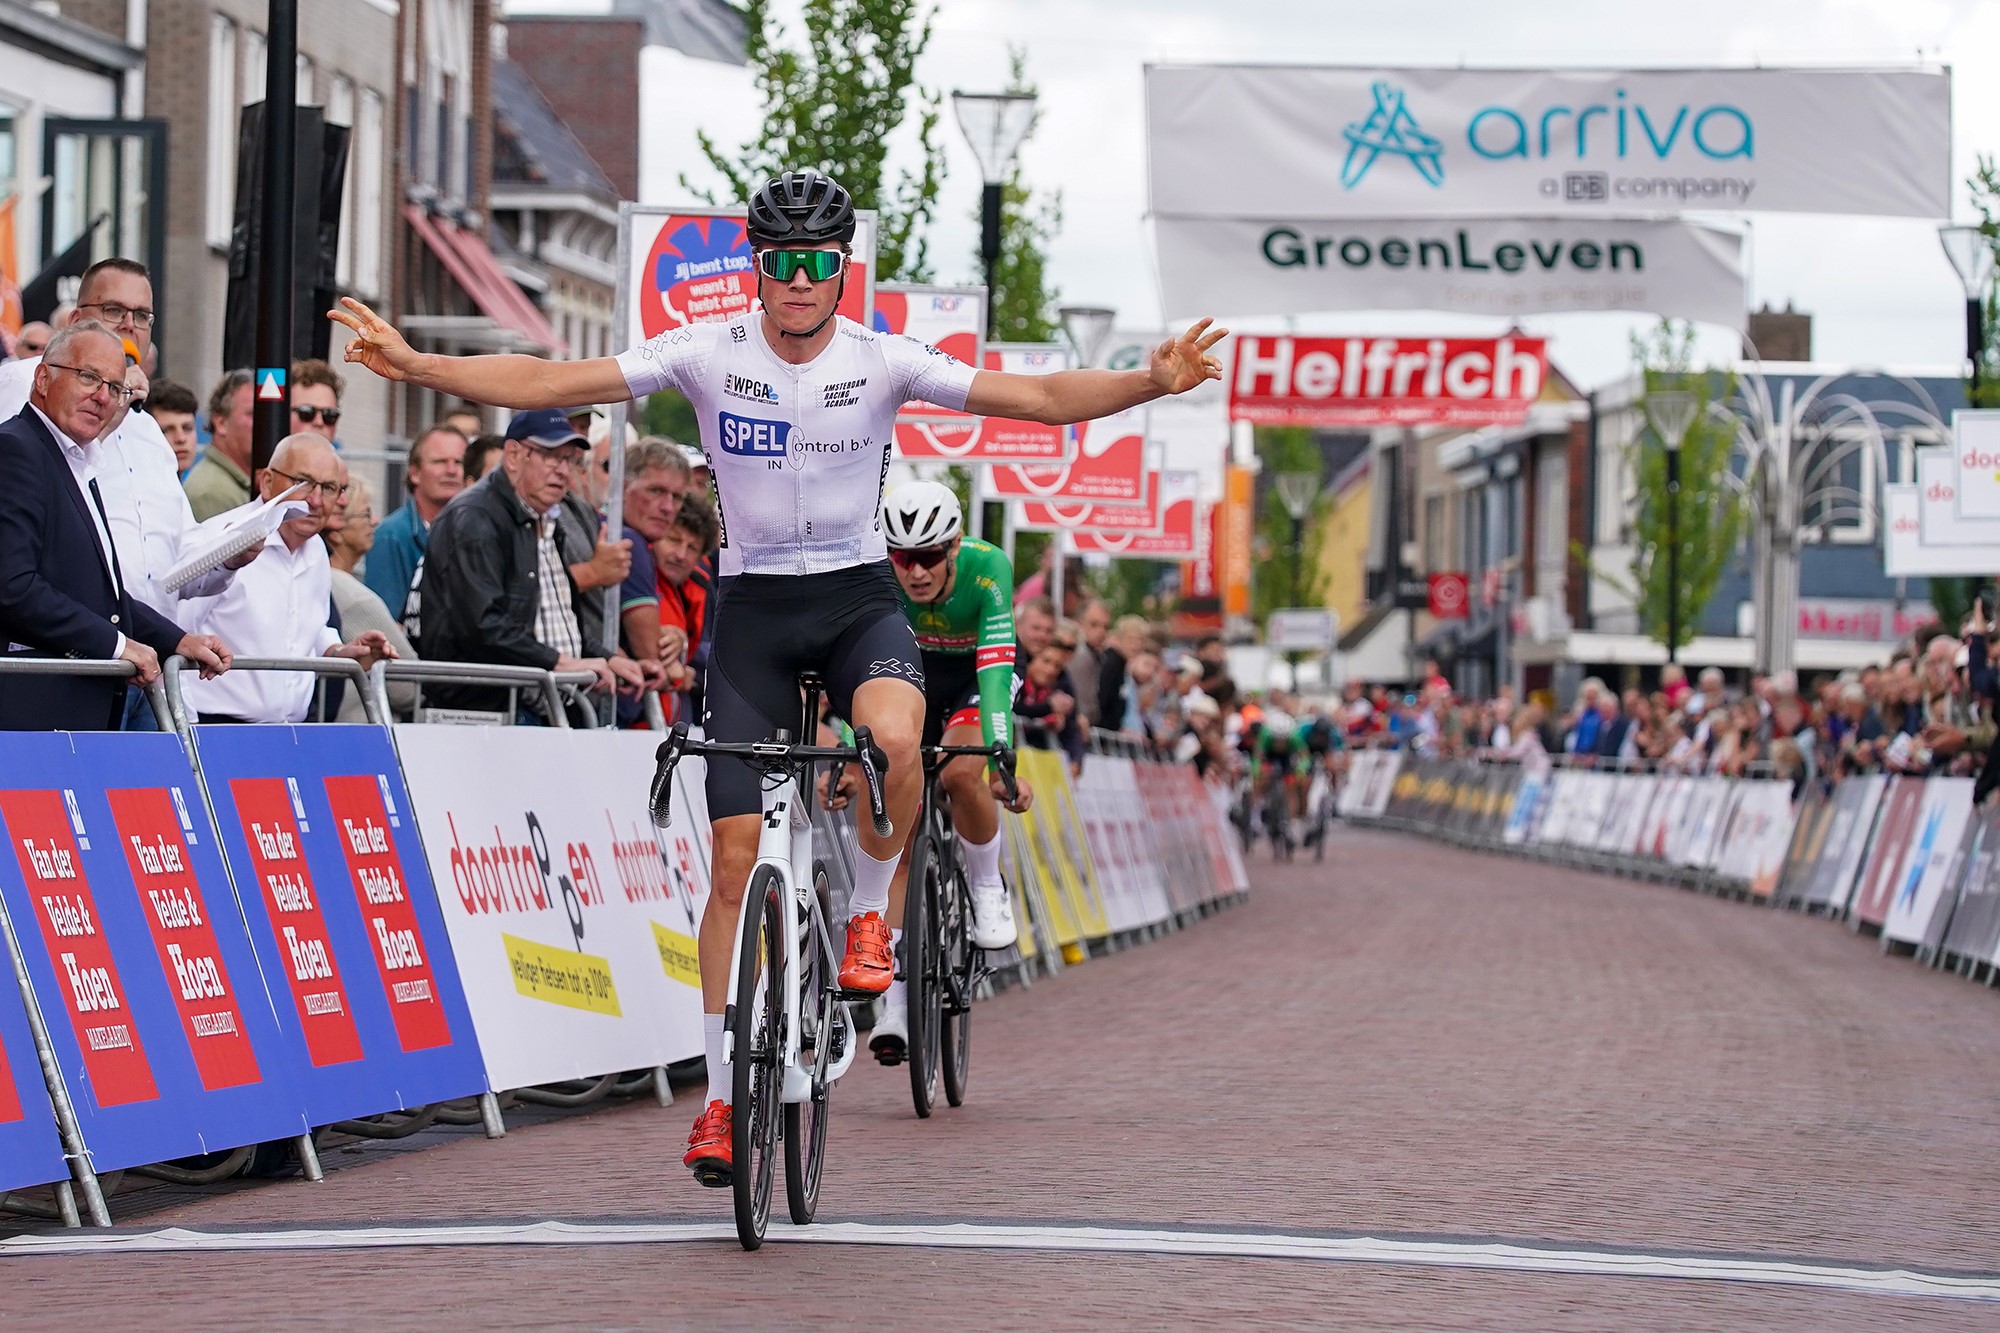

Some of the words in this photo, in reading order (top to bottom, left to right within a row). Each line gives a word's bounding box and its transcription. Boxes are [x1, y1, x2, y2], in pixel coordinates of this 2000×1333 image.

[1467, 89, 1754, 161] arriva
[1538, 177, 1558, 199] a
[1564, 173, 1608, 202] DB
[1613, 177, 1756, 204] company
[690, 258, 722, 276] bent
[1261, 227, 1645, 274] GroenLeven
[687, 296, 721, 314] hebt
[721, 293, 748, 308] een
[689, 278, 726, 297] want
[726, 275, 740, 295] jij
[730, 325, 746, 340] 83
[734, 375, 770, 399] WPGA
[823, 378, 867, 393] AMSTERDAM
[1236, 337, 1541, 400] Helfrich
[824, 390, 850, 401] RACING
[824, 397, 859, 408] ACADEMY
[724, 418, 784, 451] SPEL
[850, 436, 873, 451] b.v.
[768, 460, 782, 470] IN
[130, 835, 163, 875] Van
[157, 834, 184, 873] der
[252, 822, 280, 861] Van
[275, 822, 298, 860] der
[343, 818, 371, 855] Van
[366, 817, 390, 854] der
[23, 838, 57, 879] Van
[50, 838, 77, 878] der
[267, 874, 302, 913] Velde
[297, 873, 313, 911] &
[358, 867, 393, 905] Velde
[388, 865, 404, 903] &
[42, 896, 81, 937] Velde
[76, 894, 96, 936] &
[148, 889, 189, 929] Velde
[184, 886, 203, 927] &
[282, 926, 333, 981] Hoen
[372, 917, 423, 970] Hoen
[61, 952, 120, 1013] Hoen
[166, 943, 226, 1001] Hoen
